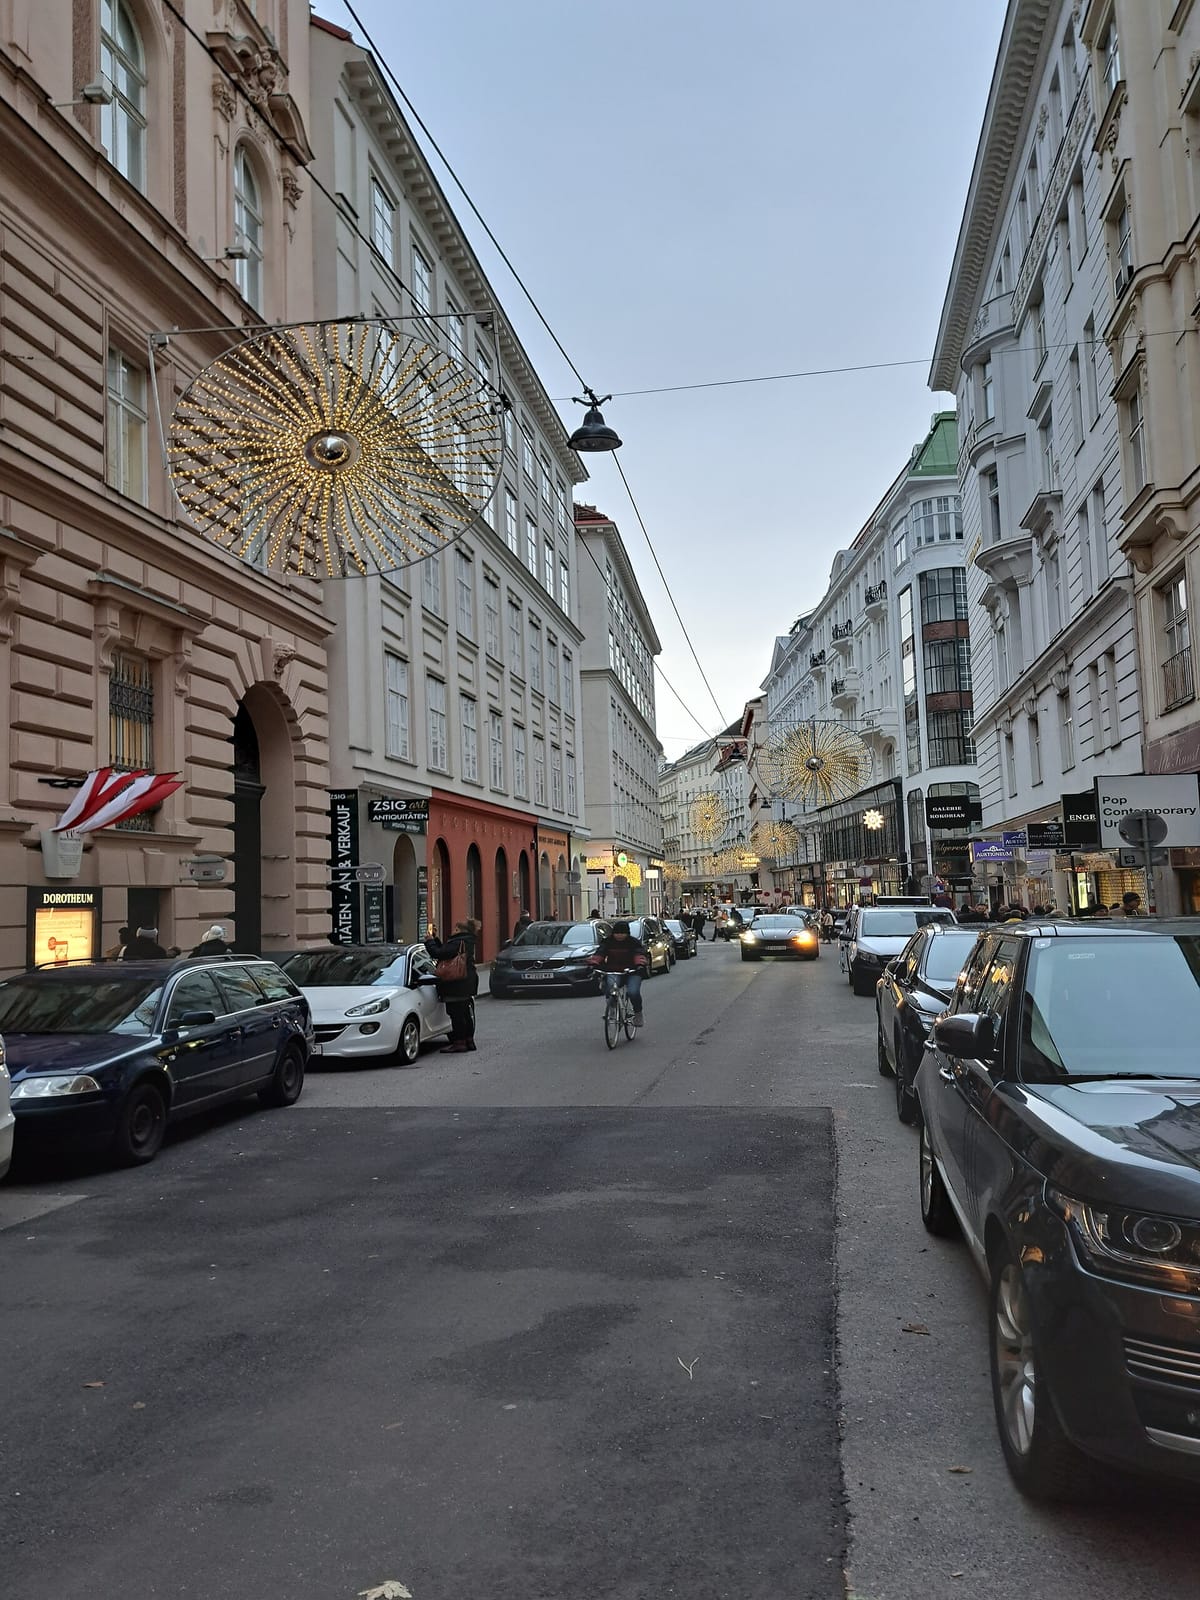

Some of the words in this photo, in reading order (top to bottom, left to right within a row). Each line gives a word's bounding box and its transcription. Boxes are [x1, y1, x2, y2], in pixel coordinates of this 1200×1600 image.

[372, 800, 407, 811] ZSIG
[408, 799, 426, 809] art
[1102, 796, 1128, 805] Pop
[372, 811, 428, 821] ANTIQUITÄTEN
[337, 804, 351, 858] VERKAUF
[338, 859, 352, 869] &
[338, 872, 352, 892] AN
[43, 893, 93, 904] DOROTHEUM
